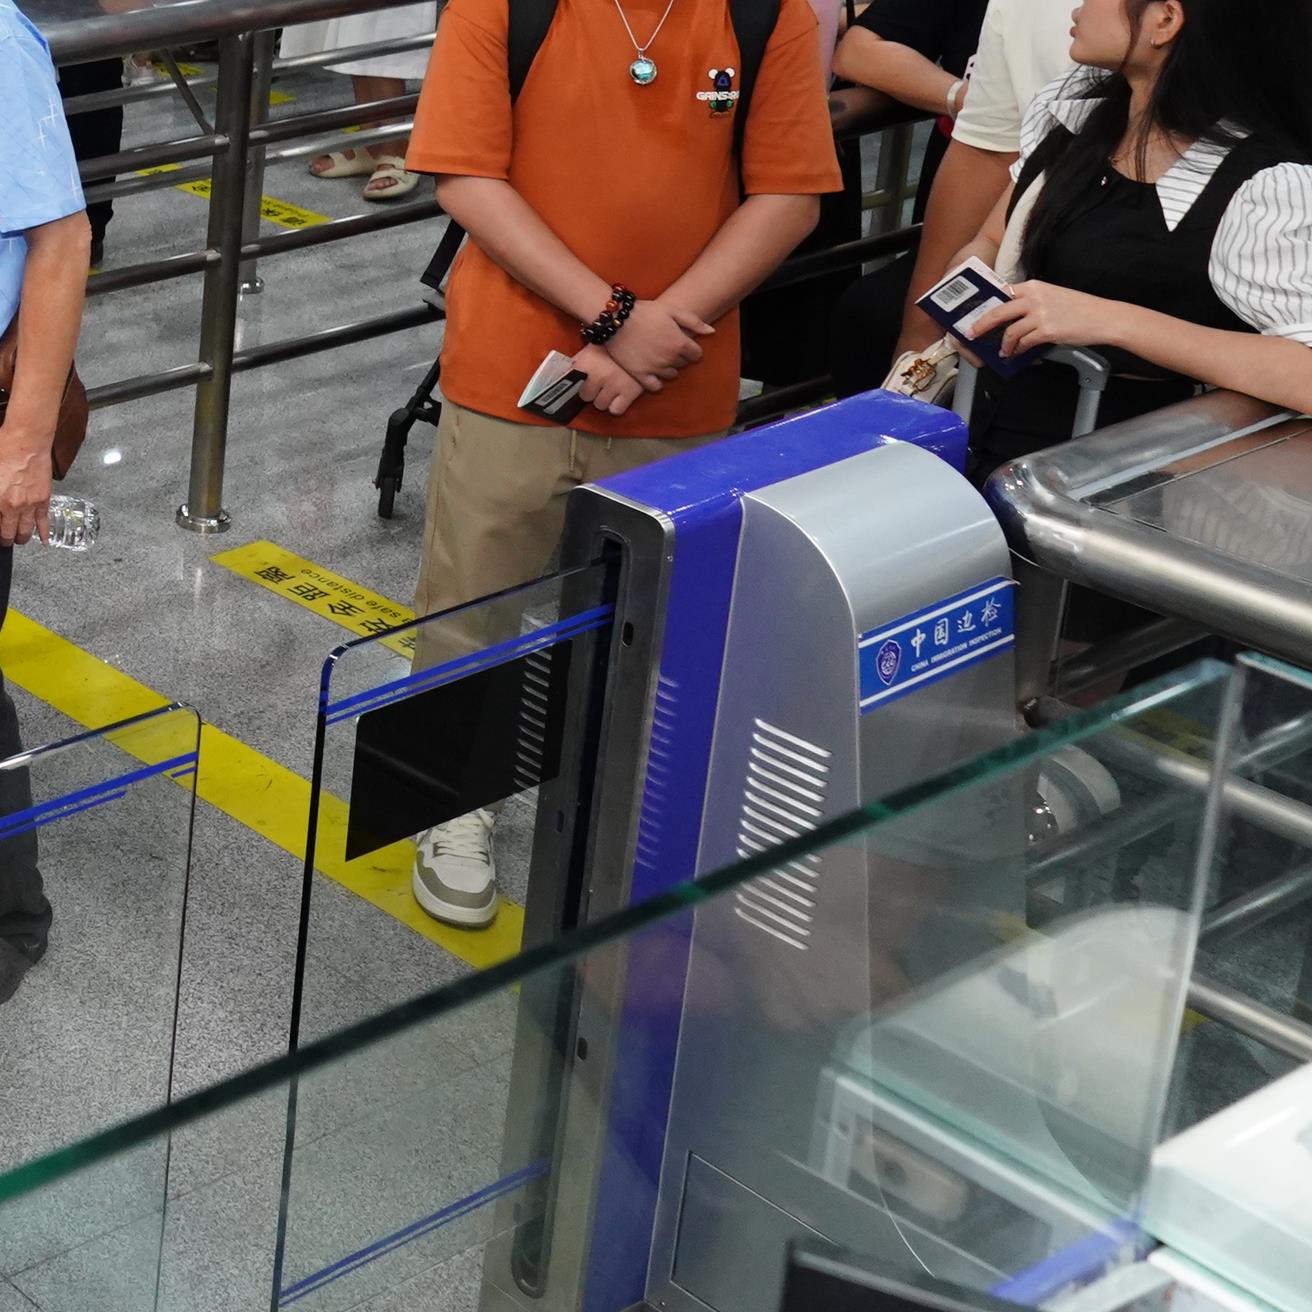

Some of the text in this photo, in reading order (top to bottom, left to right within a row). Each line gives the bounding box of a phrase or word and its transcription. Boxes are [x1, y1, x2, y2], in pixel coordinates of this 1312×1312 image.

[300, 567, 365, 601] distance
[910, 596, 1002, 658] 中国边检
[911, 658, 930, 672] CHINA
[931, 641, 968, 664] IMMIGRATION
[968, 627, 1003, 647] INSPECTION
